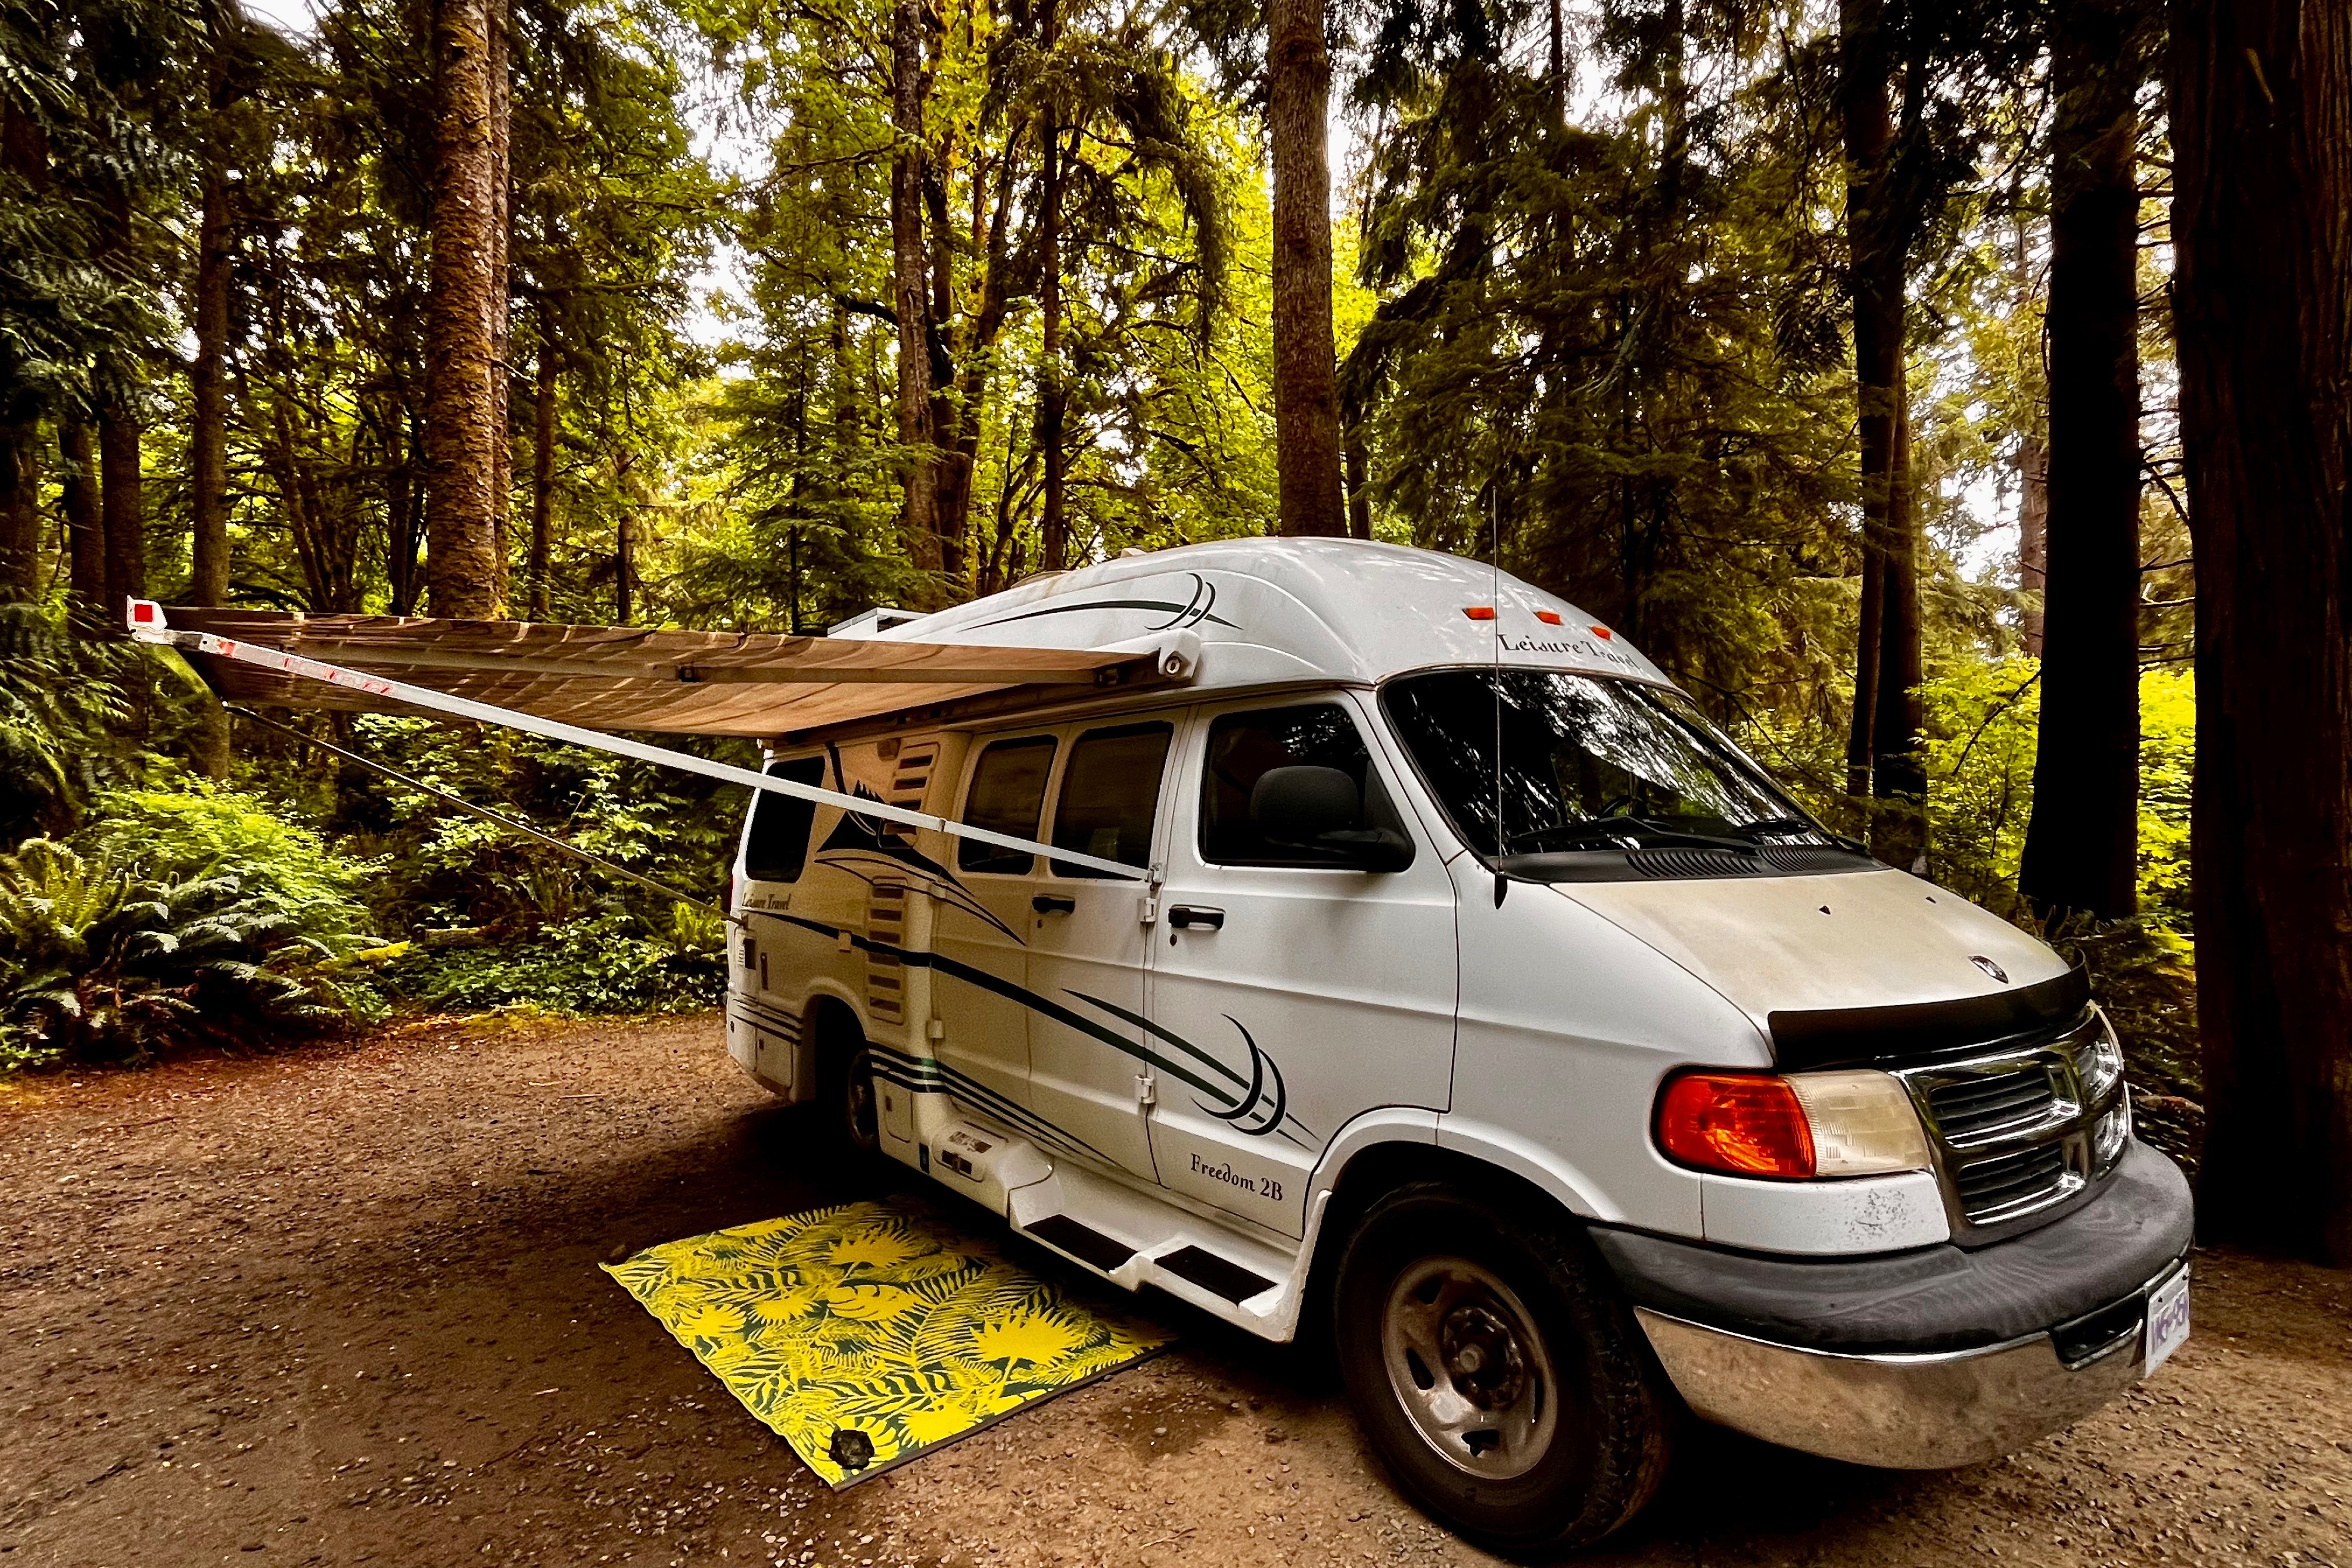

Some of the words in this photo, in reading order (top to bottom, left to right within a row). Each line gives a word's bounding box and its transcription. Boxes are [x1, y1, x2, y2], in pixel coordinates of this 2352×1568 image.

[1497, 634, 1583, 653] Leisure
[1190, 1153, 1255, 1192] Freedom
[1260, 1177, 1283, 1201] 2B
